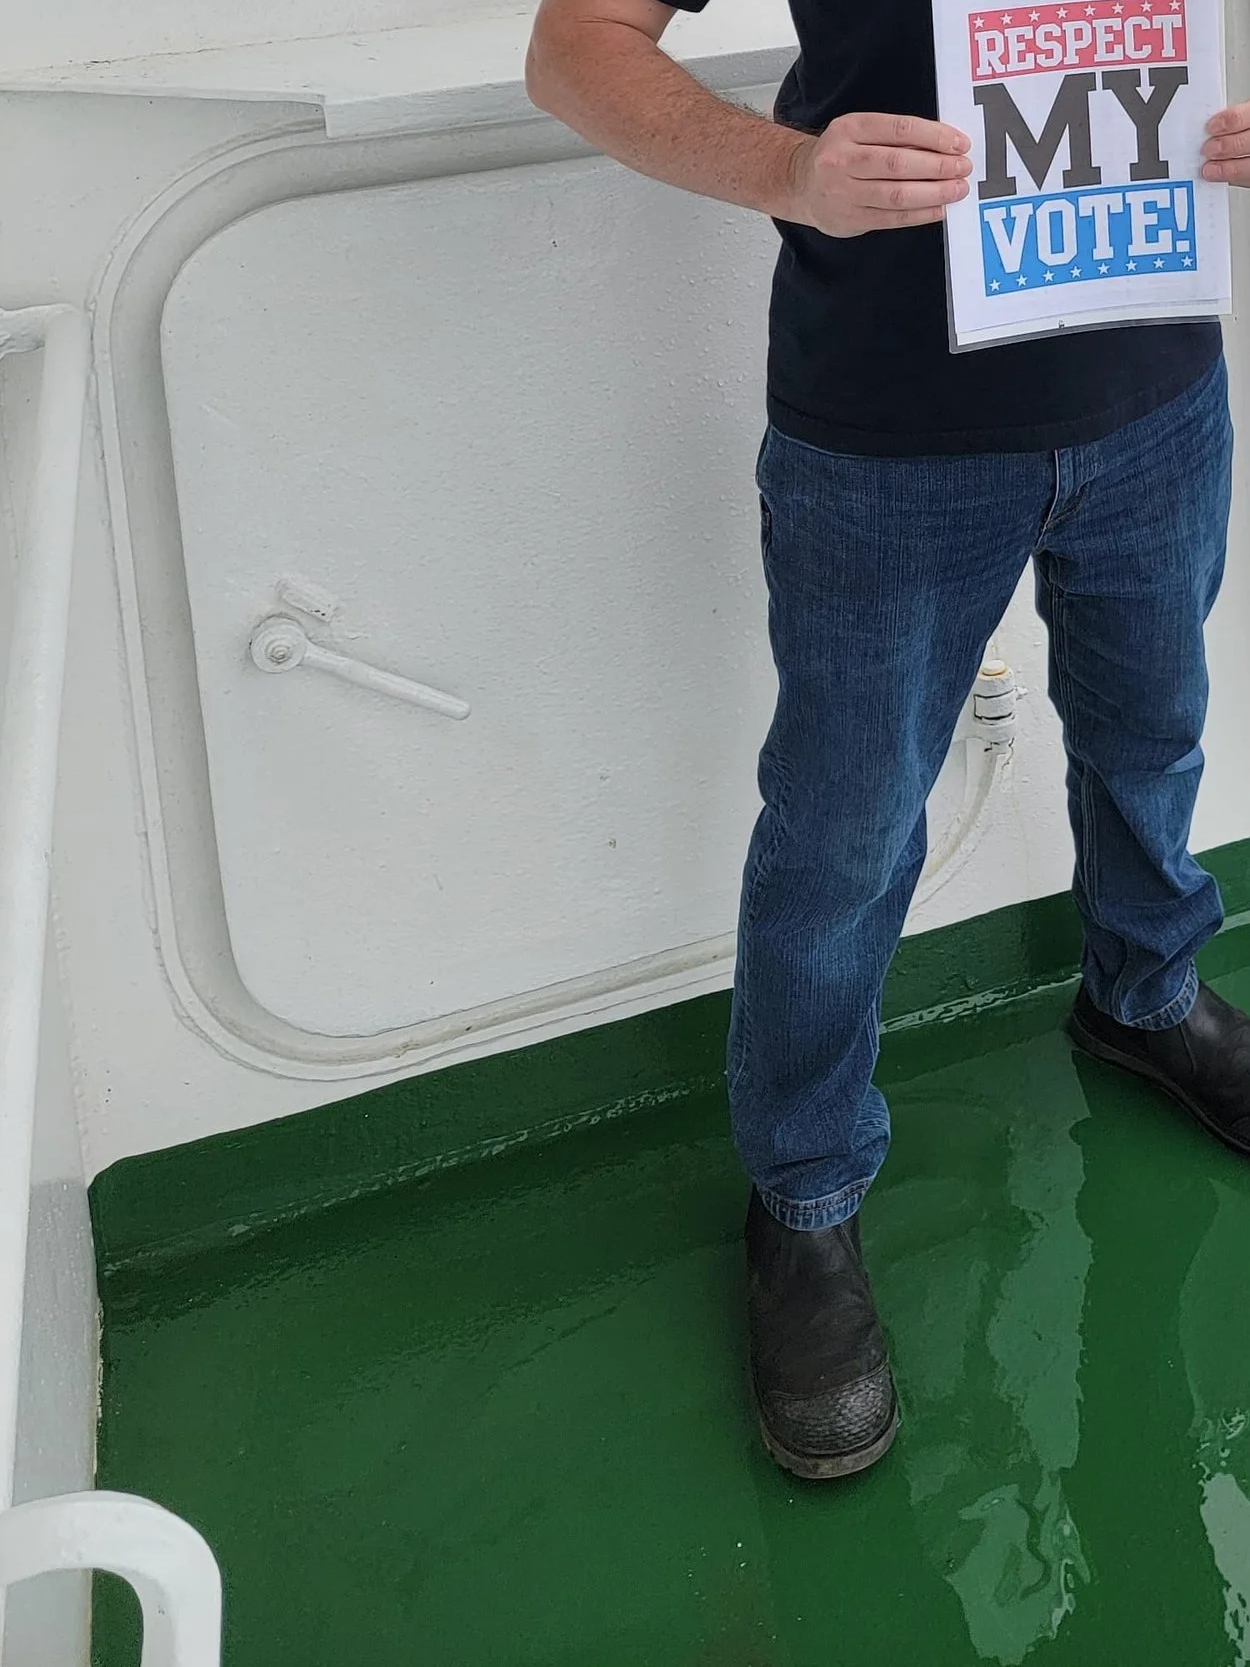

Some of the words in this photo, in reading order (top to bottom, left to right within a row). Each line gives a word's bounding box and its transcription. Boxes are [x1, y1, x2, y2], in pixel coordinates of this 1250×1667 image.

[973, 14, 1183, 77] RESPECT
[972, 66, 1189, 200] MY
[982, 187, 1191, 275] VOTE!
